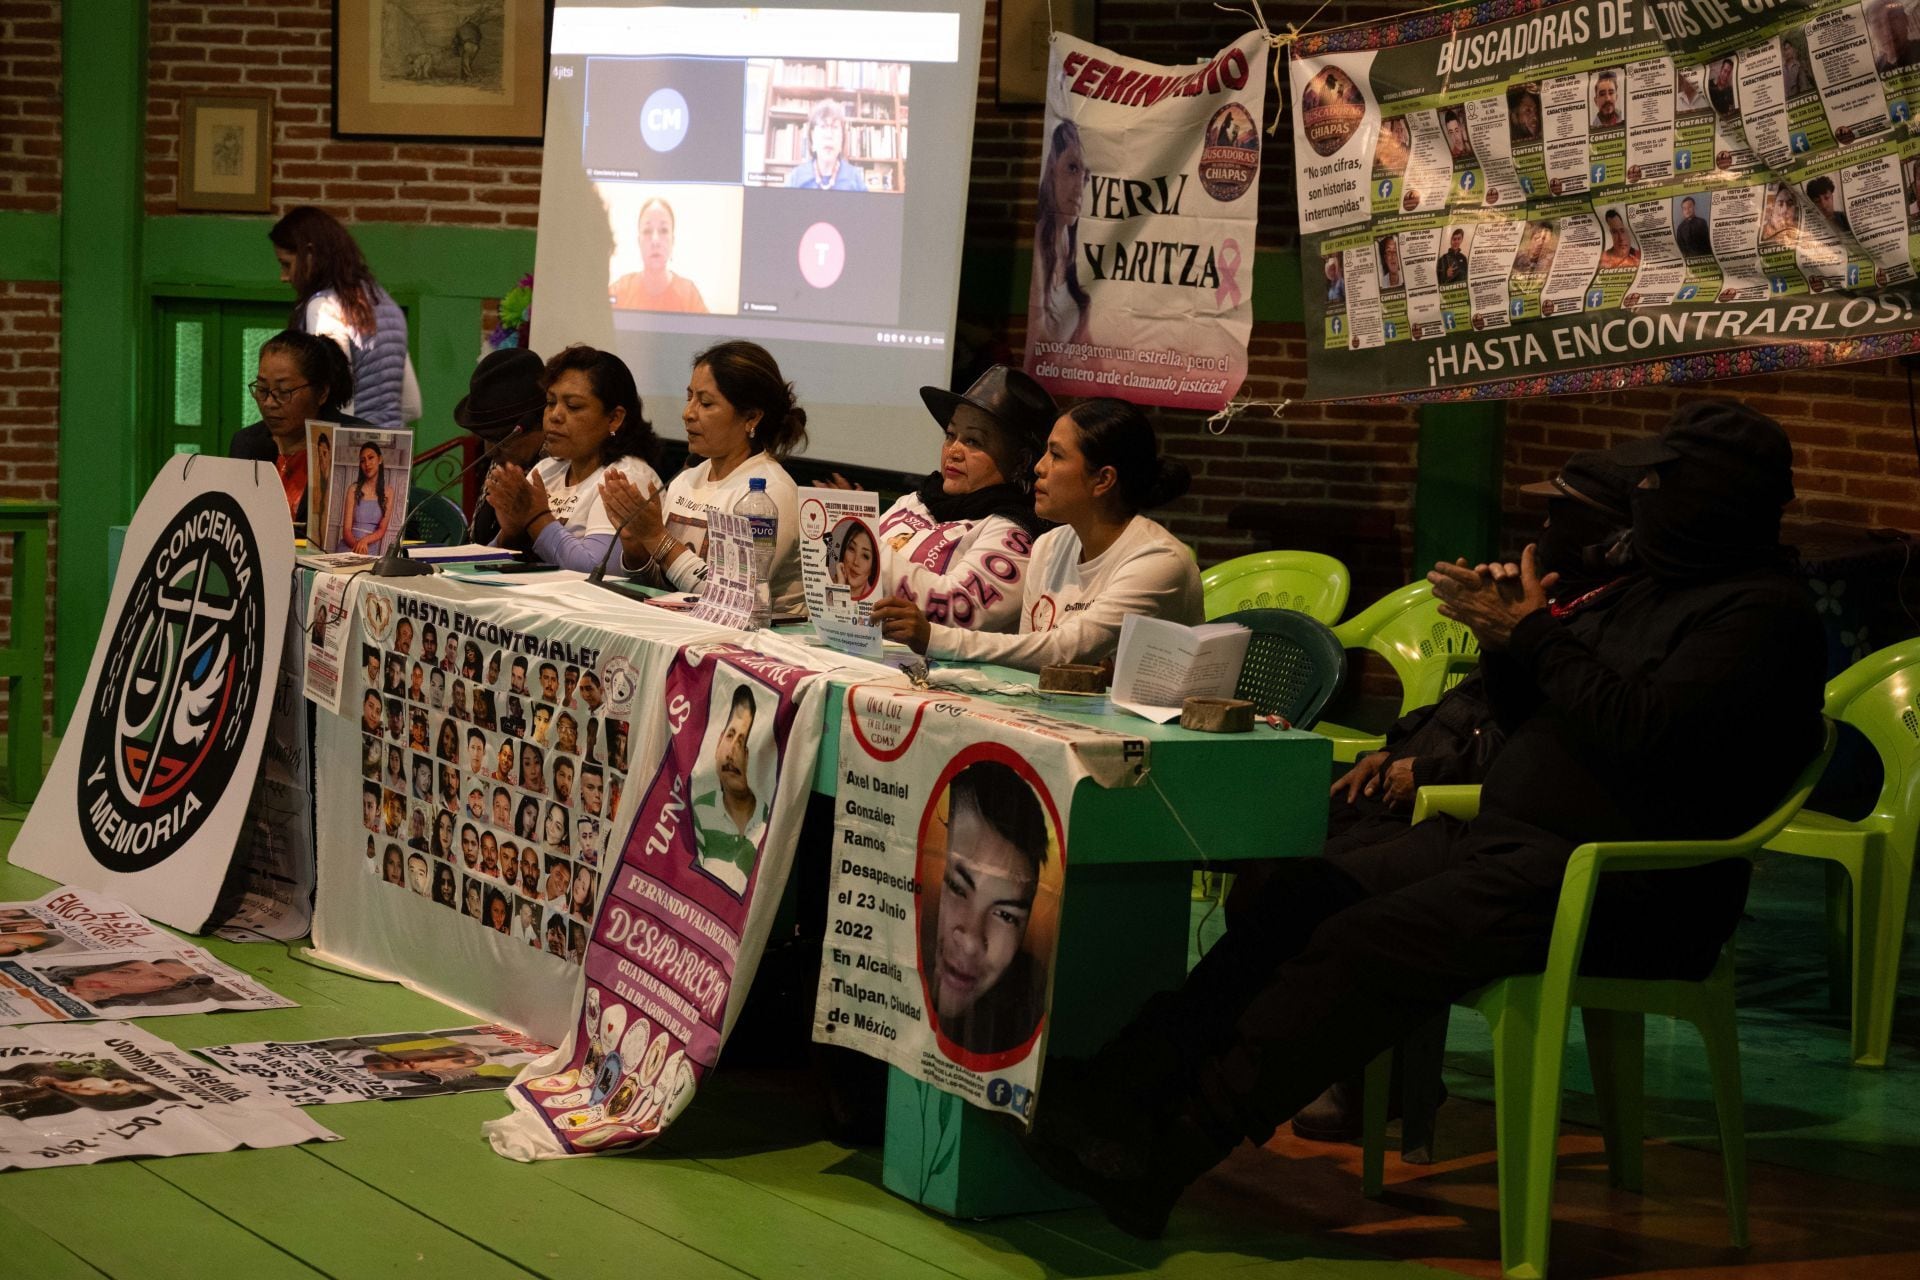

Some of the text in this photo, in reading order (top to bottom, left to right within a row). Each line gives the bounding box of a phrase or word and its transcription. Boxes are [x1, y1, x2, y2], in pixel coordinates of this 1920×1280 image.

[1436, 4, 1590, 77] BUSCADORAS
[1600, 0, 1634, 39] DE
[647, 107, 681, 131] CM
[1310, 123, 1350, 140] CHIAPAS
[1202, 147, 1258, 165] BUSCADORAS
[1320, 165, 1332, 176] son
[1334, 158, 1362, 173] cifras,
[1205, 166, 1248, 182] CHIAPAS
[1308, 179, 1356, 200] son historias
[815, 243, 829, 266] T
[1083, 240, 1220, 289] YARITZA
[1428, 293, 1912, 386] ¡HASTA ENCONTRARLOS!
[1036, 362, 1059, 378] cielo
[1062, 366, 1094, 381] entero
[1097, 370, 1121, 385] arde
[1123, 371, 1177, 390] clamando
[1187, 356, 1214, 373] pero
[1218, 355, 1229, 371] el
[156, 509, 253, 599] CONCIENCIA
[397, 593, 600, 671] HASTA ENCONTRARLES
[866, 695, 903, 720] UNA LUZ
[870, 732, 896, 747] CDMX
[86, 756, 107, 787] Y
[846, 770, 909, 800] Axel Daniel
[88, 791, 203, 856] MEMORIA
[845, 800, 896, 826] González
[843, 829, 886, 853] Ramos
[841, 860, 922, 895] Desaparecido
[627, 874, 689, 920] FERNANDO
[837, 890, 853, 906] el
[857, 892, 876, 911] 23
[688, 908, 724, 944] VALADEZ
[834, 919, 874, 941] 2022
[833, 948, 850, 967] En
[617, 959, 684, 1012] GUAYMAS SONORA
[830, 977, 922, 1022] Tlalpan, Ciudad
[615, 980, 627, 996] EL
[633, 992, 645, 1008] DE
[643, 999, 671, 1026] AGOSTO
[827, 1007, 897, 1041] de México
